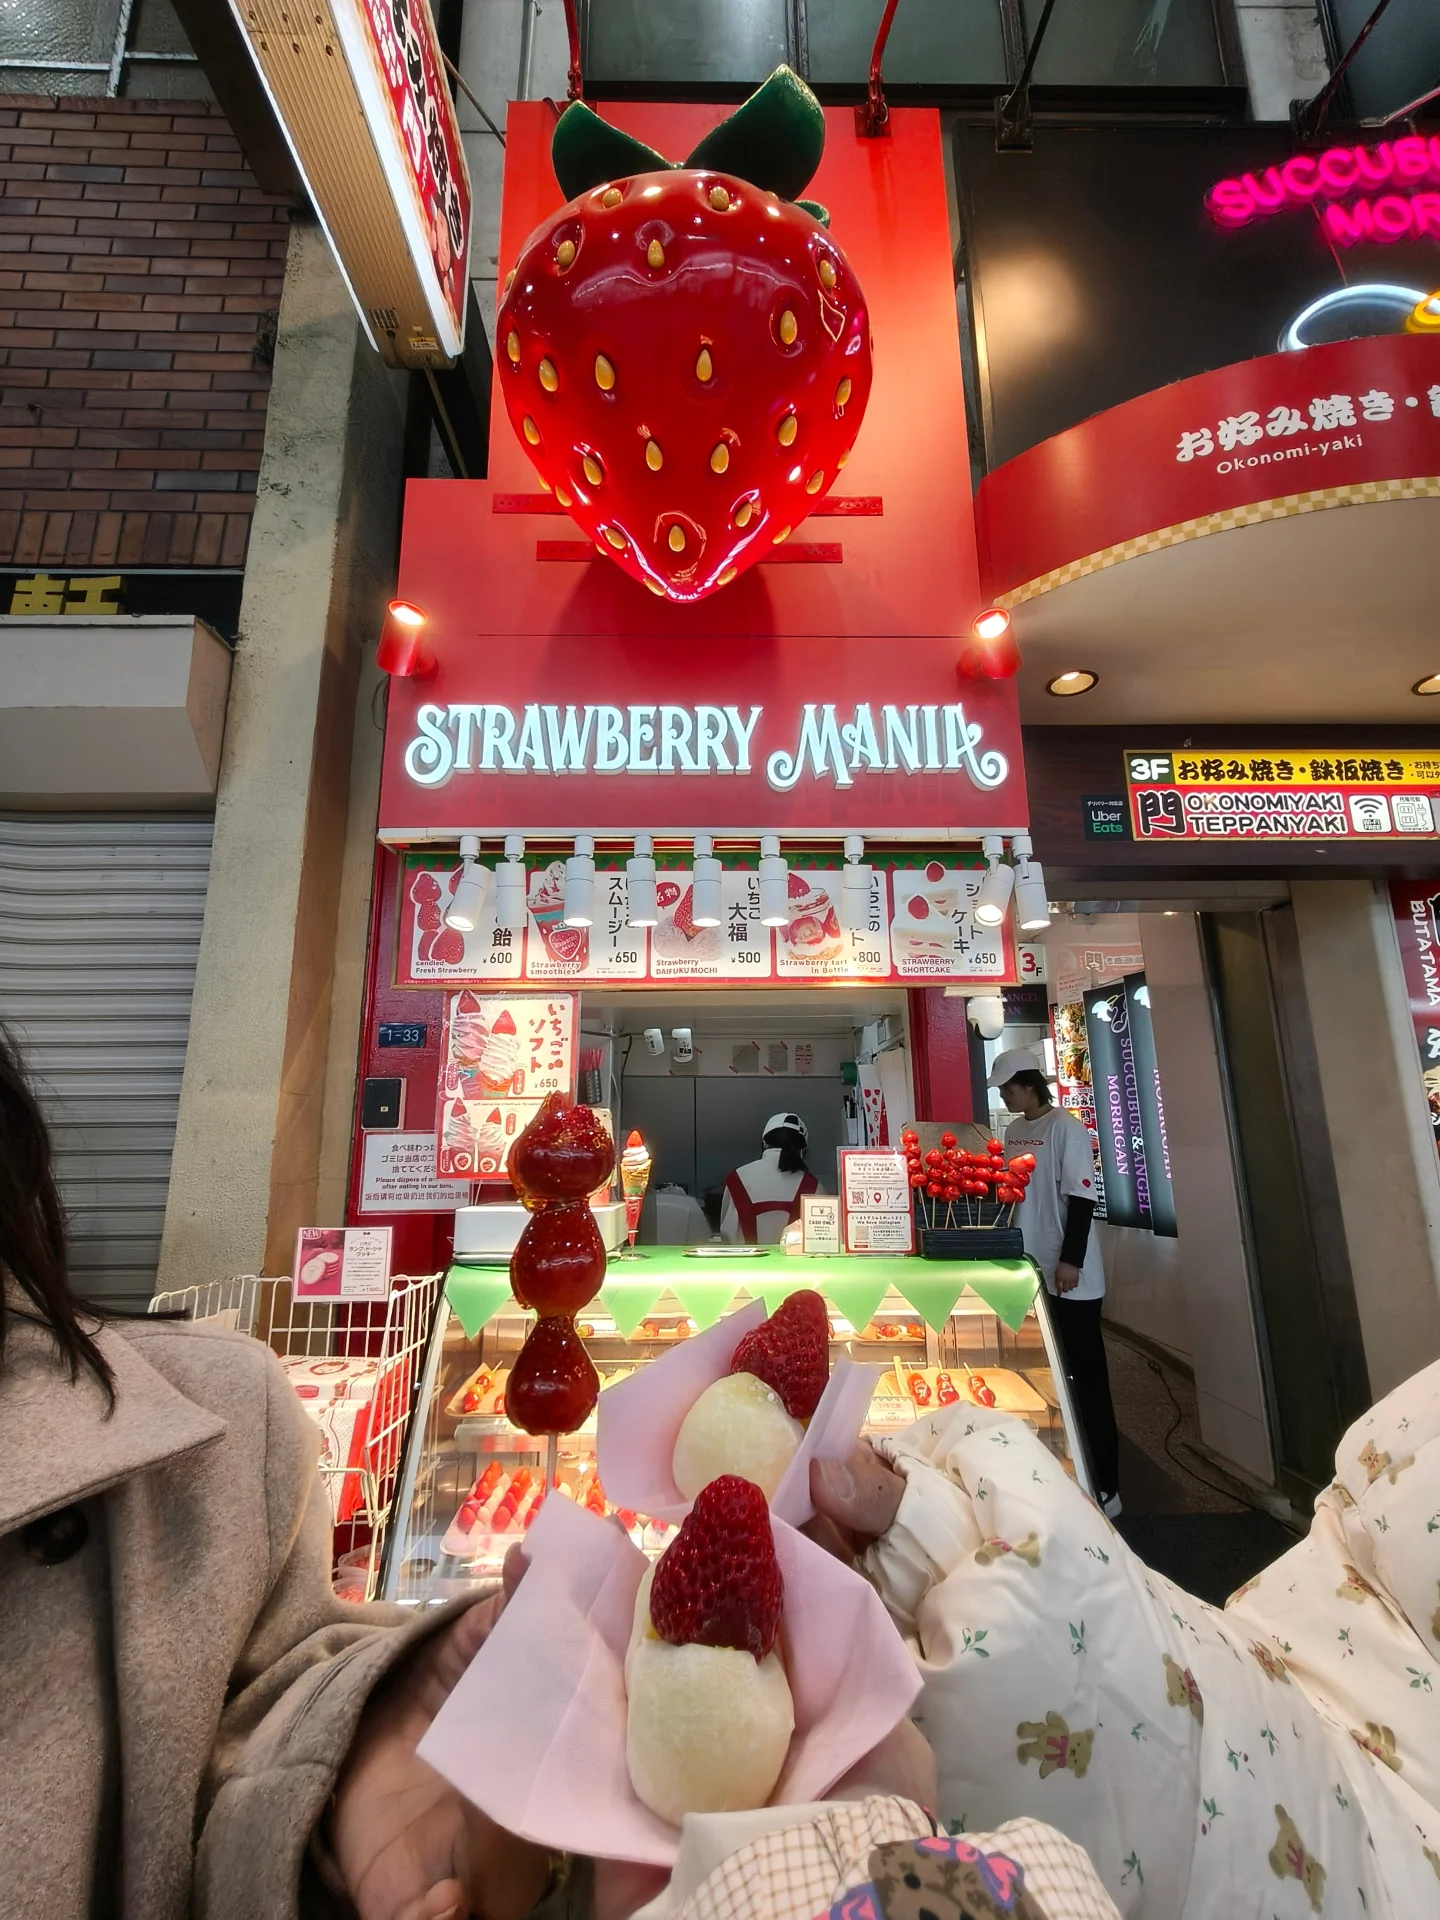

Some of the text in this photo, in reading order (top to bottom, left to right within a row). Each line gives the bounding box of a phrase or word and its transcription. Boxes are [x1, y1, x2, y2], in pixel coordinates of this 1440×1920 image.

[1216, 434, 1363, 475] Okonomi-yaki
[405, 702, 1009, 790] STRAWBERRY MANIA
[1130, 758, 1170, 781] 3F
[1177, 758, 1405, 782] お好み焼き・鉄板焼き
[1187, 794, 1343, 811] OKONOMIYAKI
[1091, 811, 1122, 821] Uber
[1092, 822, 1123, 833] Eats
[1187, 815, 1347, 833] TEPPANYAKI
[608, 877, 624, 947] スムージー
[728, 902, 748, 942] 大福
[951, 909, 970, 954] ケーキ
[483, 952, 512, 964] ¥600
[608, 951, 638, 963] ¥650
[656, 958, 699, 967] Strawberry
[731, 951, 761, 963] ¥500
[780, 959, 829, 967] Strawberry
[852, 951, 881, 963] ¥800
[969, 953, 997, 964] ¥650
[438, 967, 477, 975] Strawberry
[531, 961, 582, 970] Strawberry
[656, 967, 690, 975] DAIFUKU
[387, 1029, 419, 1042] 1-33
[547, 1003, 568, 1056] いちご
[529, 1019, 546, 1073] ソフト
[534, 1078, 558, 1089] ¥650
[1107, 1074, 1129, 1176] MORRIGAN
